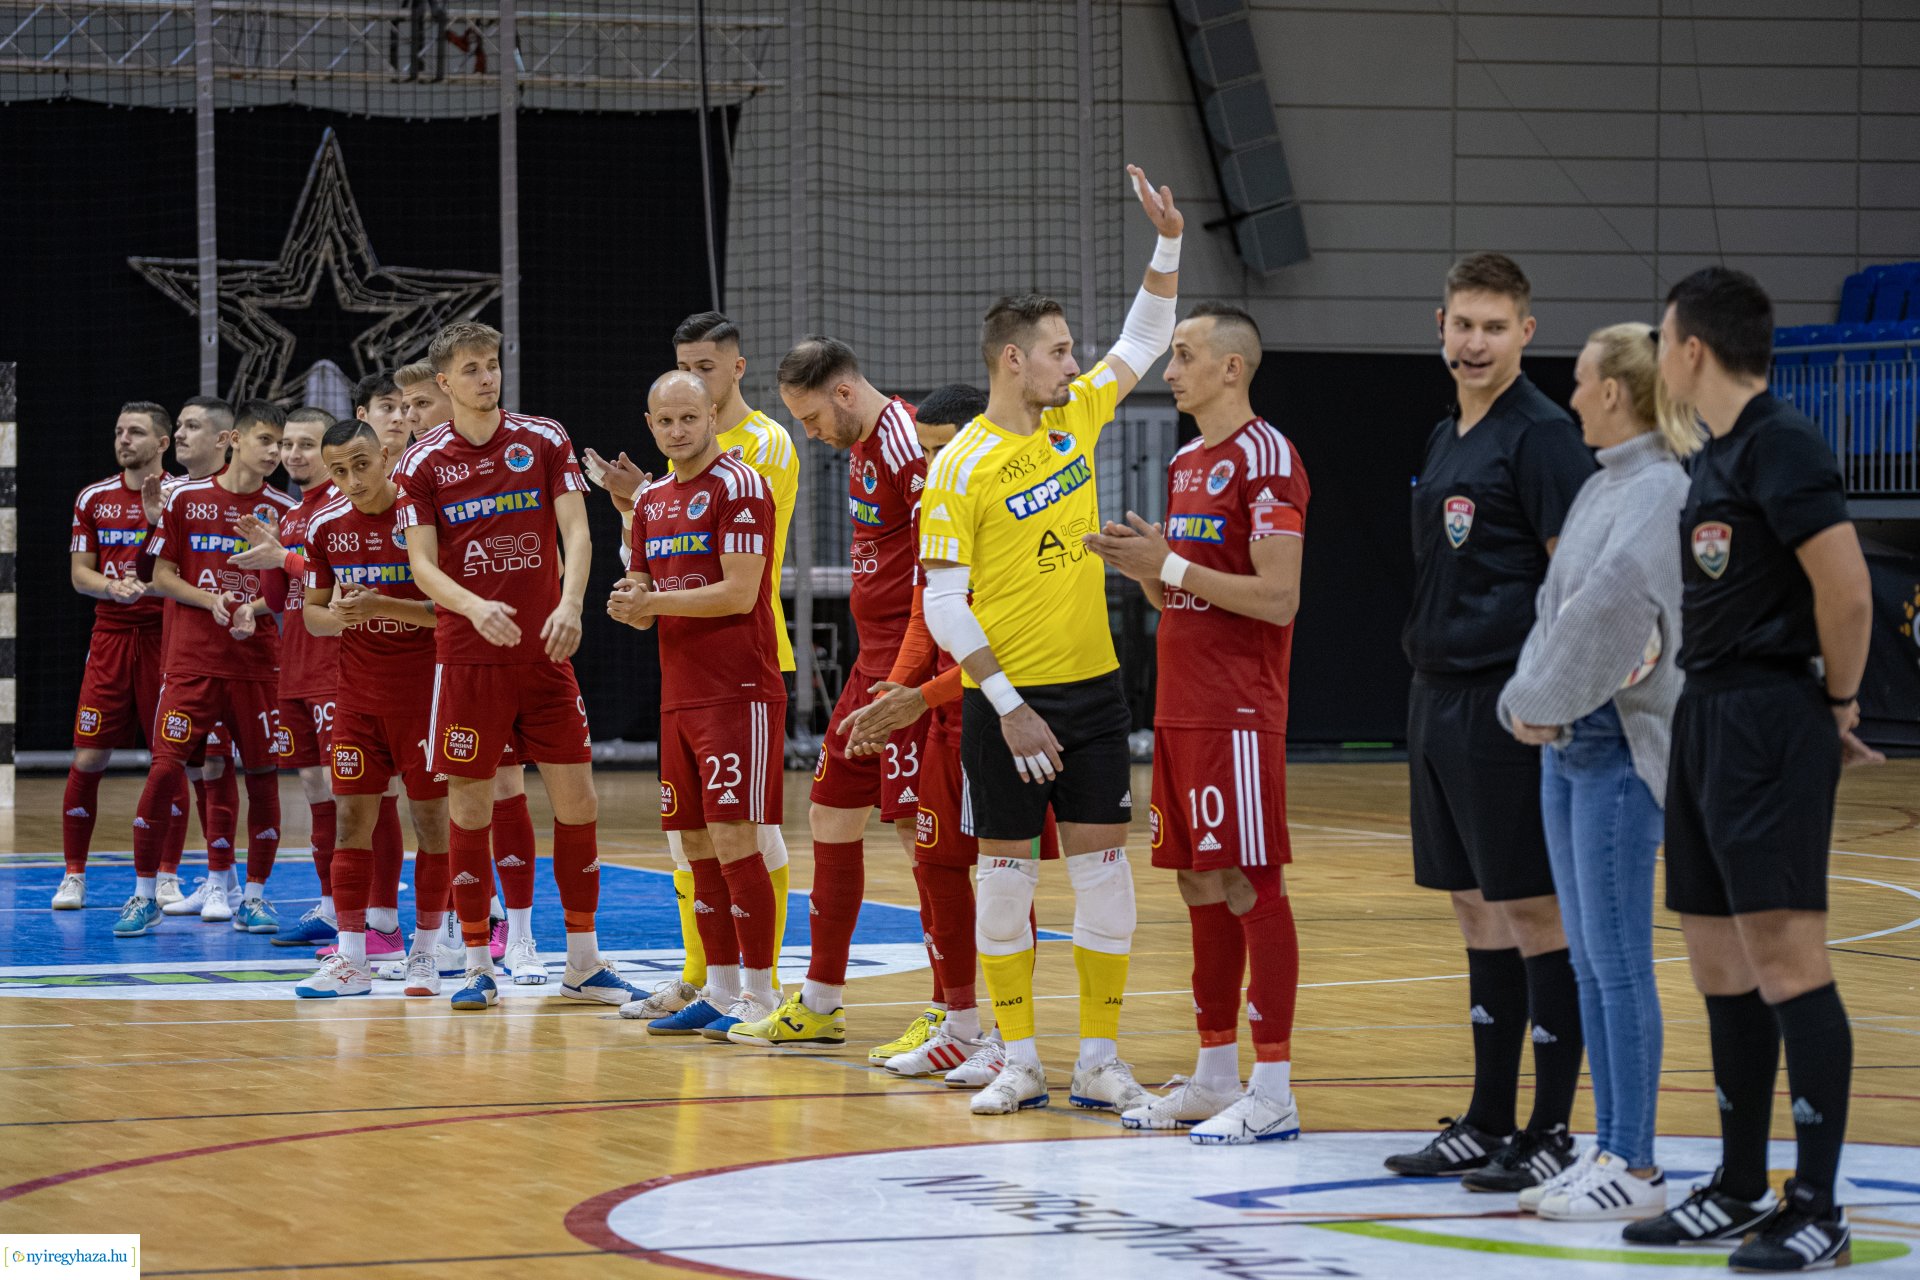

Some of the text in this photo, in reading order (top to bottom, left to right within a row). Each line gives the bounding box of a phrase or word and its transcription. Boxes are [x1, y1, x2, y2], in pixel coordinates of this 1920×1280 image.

[434, 463, 470, 485] 383
[999, 454, 1037, 484] 383
[1008, 456, 1091, 519] TiPPMIX
[93, 504, 122, 519] 383
[186, 502, 219, 520] 383
[444, 490, 540, 524] TiPPMIX
[1254, 506, 1274, 530] C
[97, 530, 148, 545] TiPPM
[1168, 516, 1223, 541] PPMIX
[190, 535, 250, 553] TiPPM
[327, 532, 360, 553] 383
[463, 531, 541, 564] A'90
[645, 534, 709, 558] iPPMIX
[463, 554, 542, 577] STUDIO
[851, 559, 878, 574] DIO
[197, 568, 260, 593] A'90
[653, 573, 708, 593] '90
[1164, 592, 1211, 612] UDIO
[81, 711, 97, 722] 99.4
[168, 716, 187, 728] 99.4
[81, 723, 91, 731] FM
[170, 729, 181, 739] FM
[449, 741, 473, 750] SUNSHINE
[450, 731, 474, 744] 99.4
[336, 751, 358, 762] 99.4
[453, 748, 467, 757] FM
[885, 740, 919, 780] 33
[341, 767, 353, 775] FM
[706, 752, 742, 790] 23
[1189, 785, 1225, 829] 10
[918, 831, 927, 841] FM
[1198, 842, 1222, 851] adidas
[497, 859, 527, 867] adidas
[452, 877, 480, 886] adidas
[996, 996, 1023, 1007] JAKO
